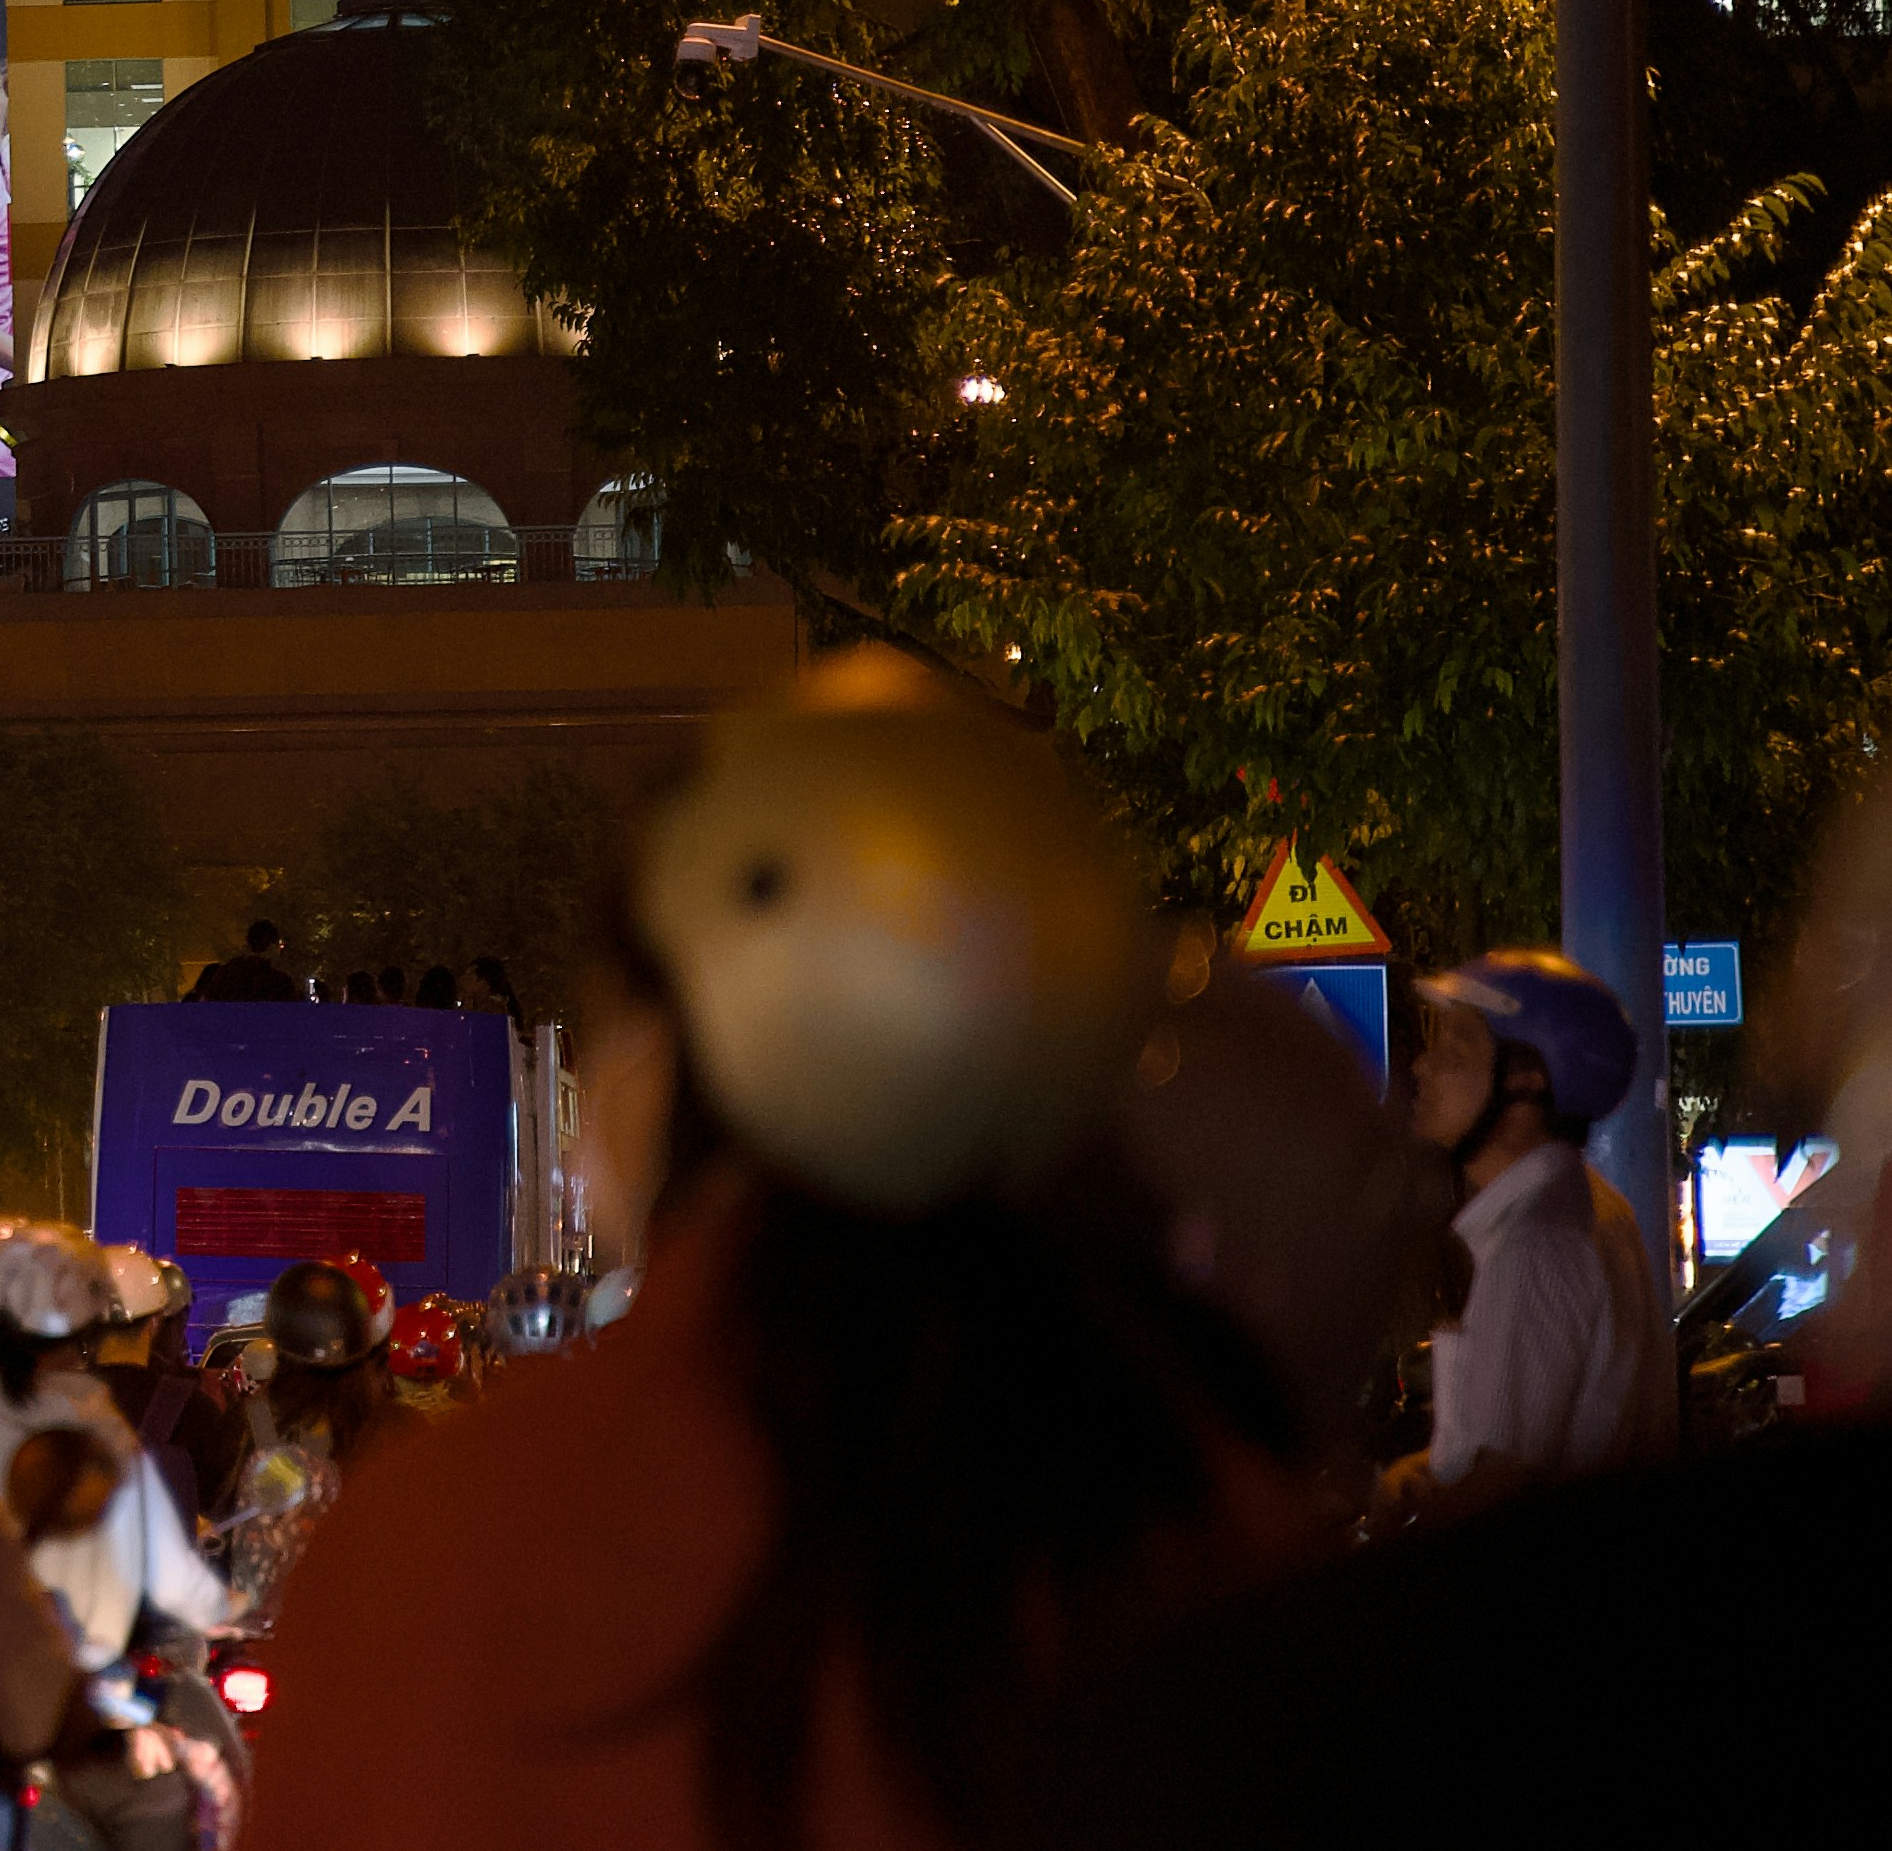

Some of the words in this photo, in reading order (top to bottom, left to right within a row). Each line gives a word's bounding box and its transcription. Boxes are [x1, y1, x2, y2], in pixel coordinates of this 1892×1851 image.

[1289, 882, 1317, 903] ĐI
[1264, 913, 1348, 943] CHẬM
[1663, 953, 1710, 977] ỜNG
[1664, 985, 1726, 1015] HUYÊN
[172, 1079, 377, 1131] Double
[385, 1086, 431, 1132] A
